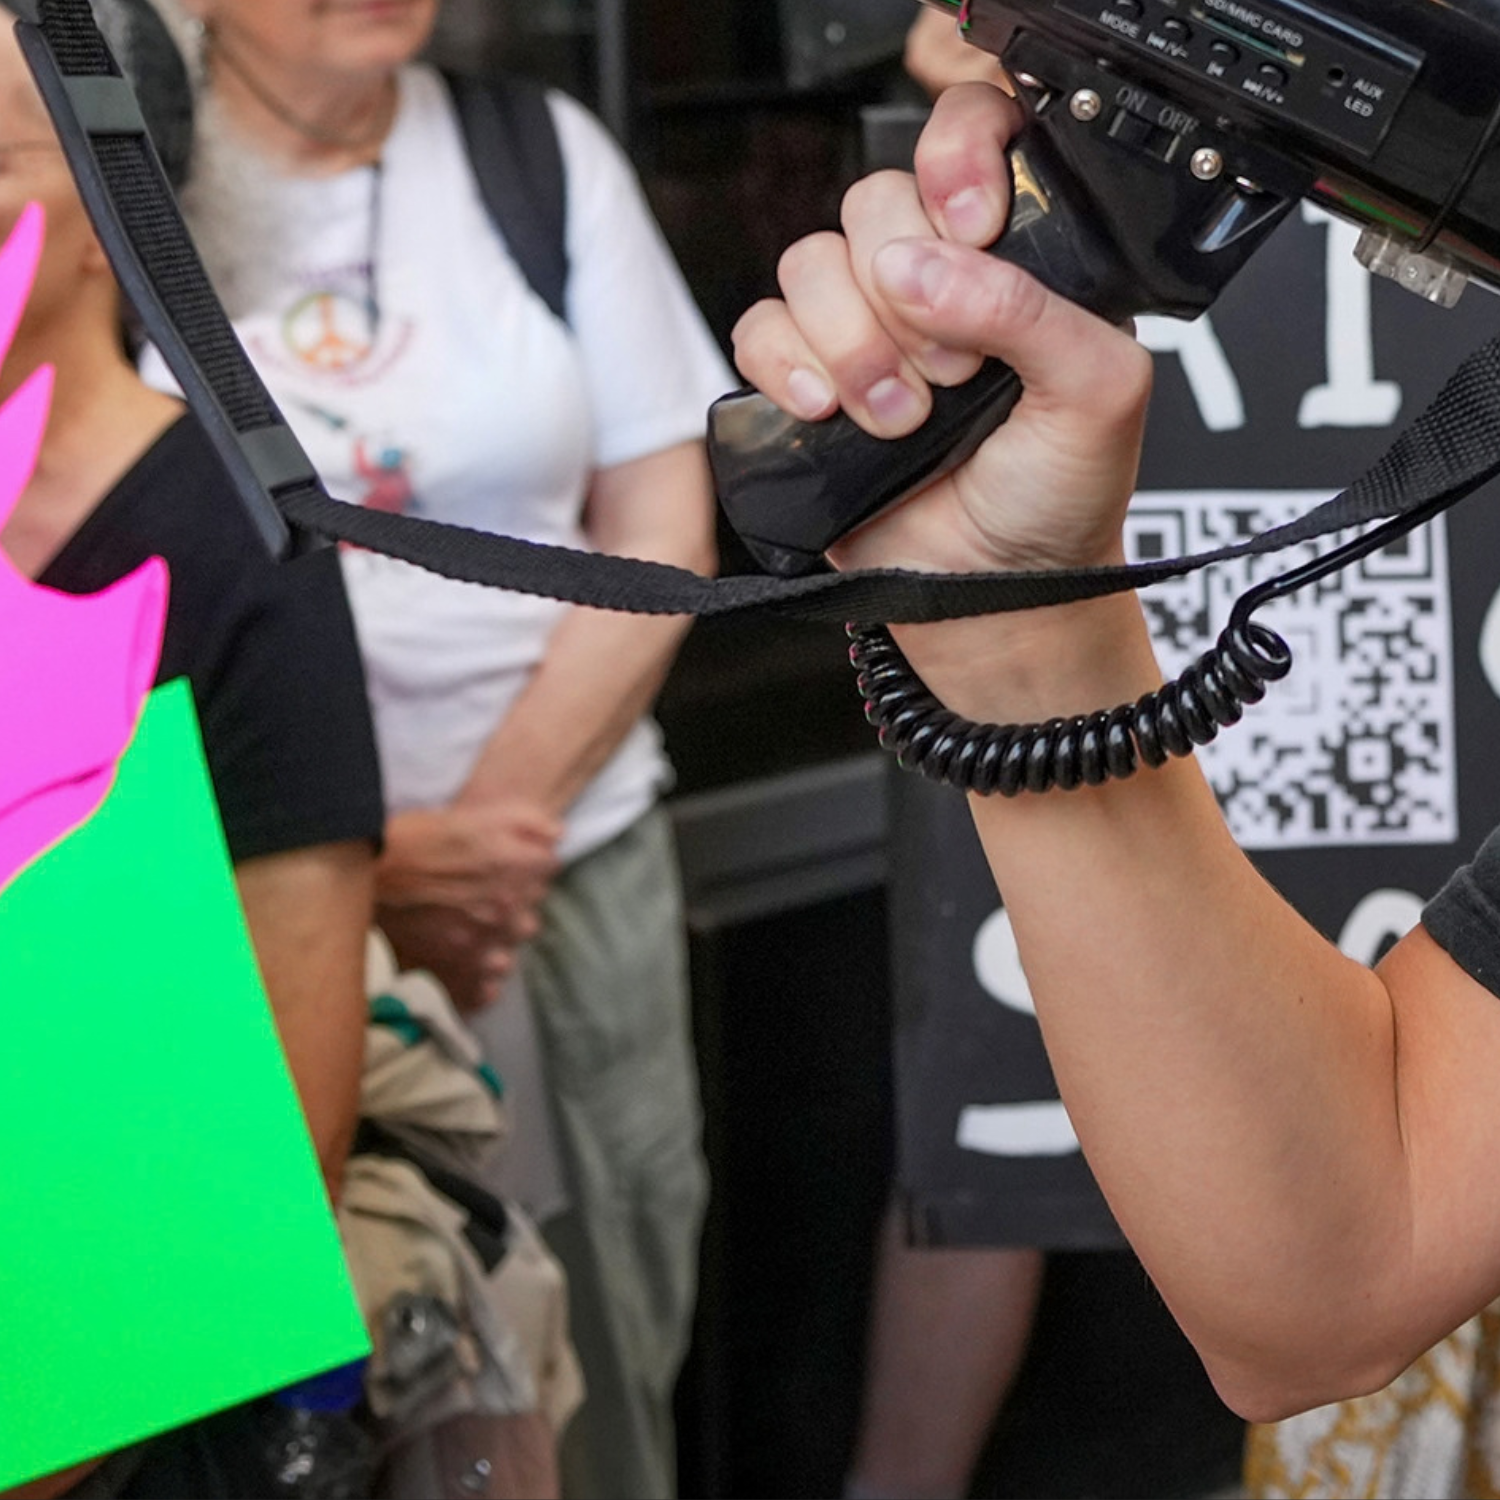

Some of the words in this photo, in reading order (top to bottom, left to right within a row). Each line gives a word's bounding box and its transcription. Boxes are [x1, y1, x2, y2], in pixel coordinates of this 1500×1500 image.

[1099, 10, 1141, 40] MODE
[1261, 19, 1304, 48] CARD
[1353, 78, 1385, 101] AUX
[1115, 86, 1148, 113] ON
[1158, 105, 1200, 136] OFF
[1343, 96, 1374, 118] LED
